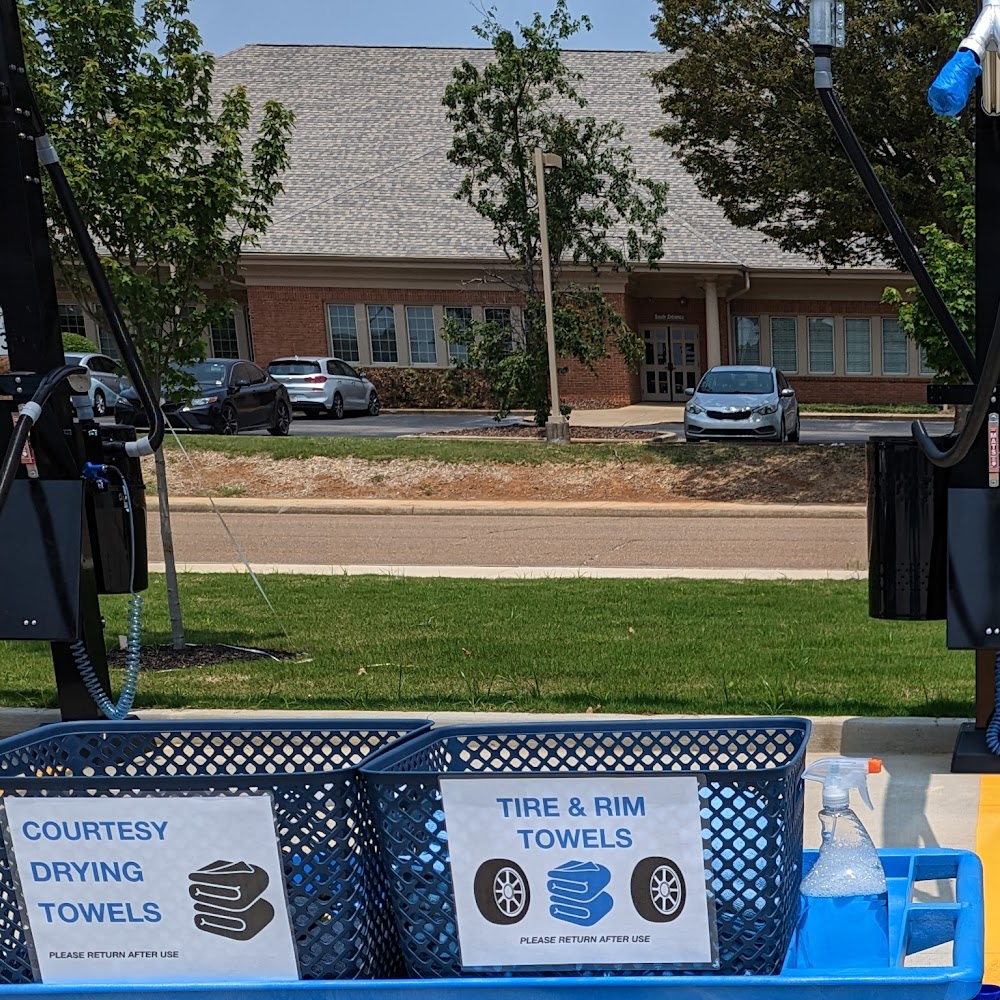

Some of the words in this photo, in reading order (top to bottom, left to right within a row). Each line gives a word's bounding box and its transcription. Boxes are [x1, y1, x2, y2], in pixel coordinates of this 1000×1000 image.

[496, 797, 560, 818] TIRE
[568, 797, 587, 817] &
[594, 796, 646, 816] RIM
[22, 820, 168, 841] COURTESY
[517, 828, 633, 849] TOWELS
[30, 861, 144, 882] DRYING
[38, 902, 162, 923] TOWELS
[520, 936, 557, 944] PLEASE
[558, 935, 597, 944] RETURN
[599, 935, 630, 943] AFTER
[632, 935, 651, 943] USE
[49, 951, 84, 959] PLEASE
[87, 951, 126, 959] RETURN
[128, 950, 158, 959] AFTER
[159, 950, 179, 958] USE
